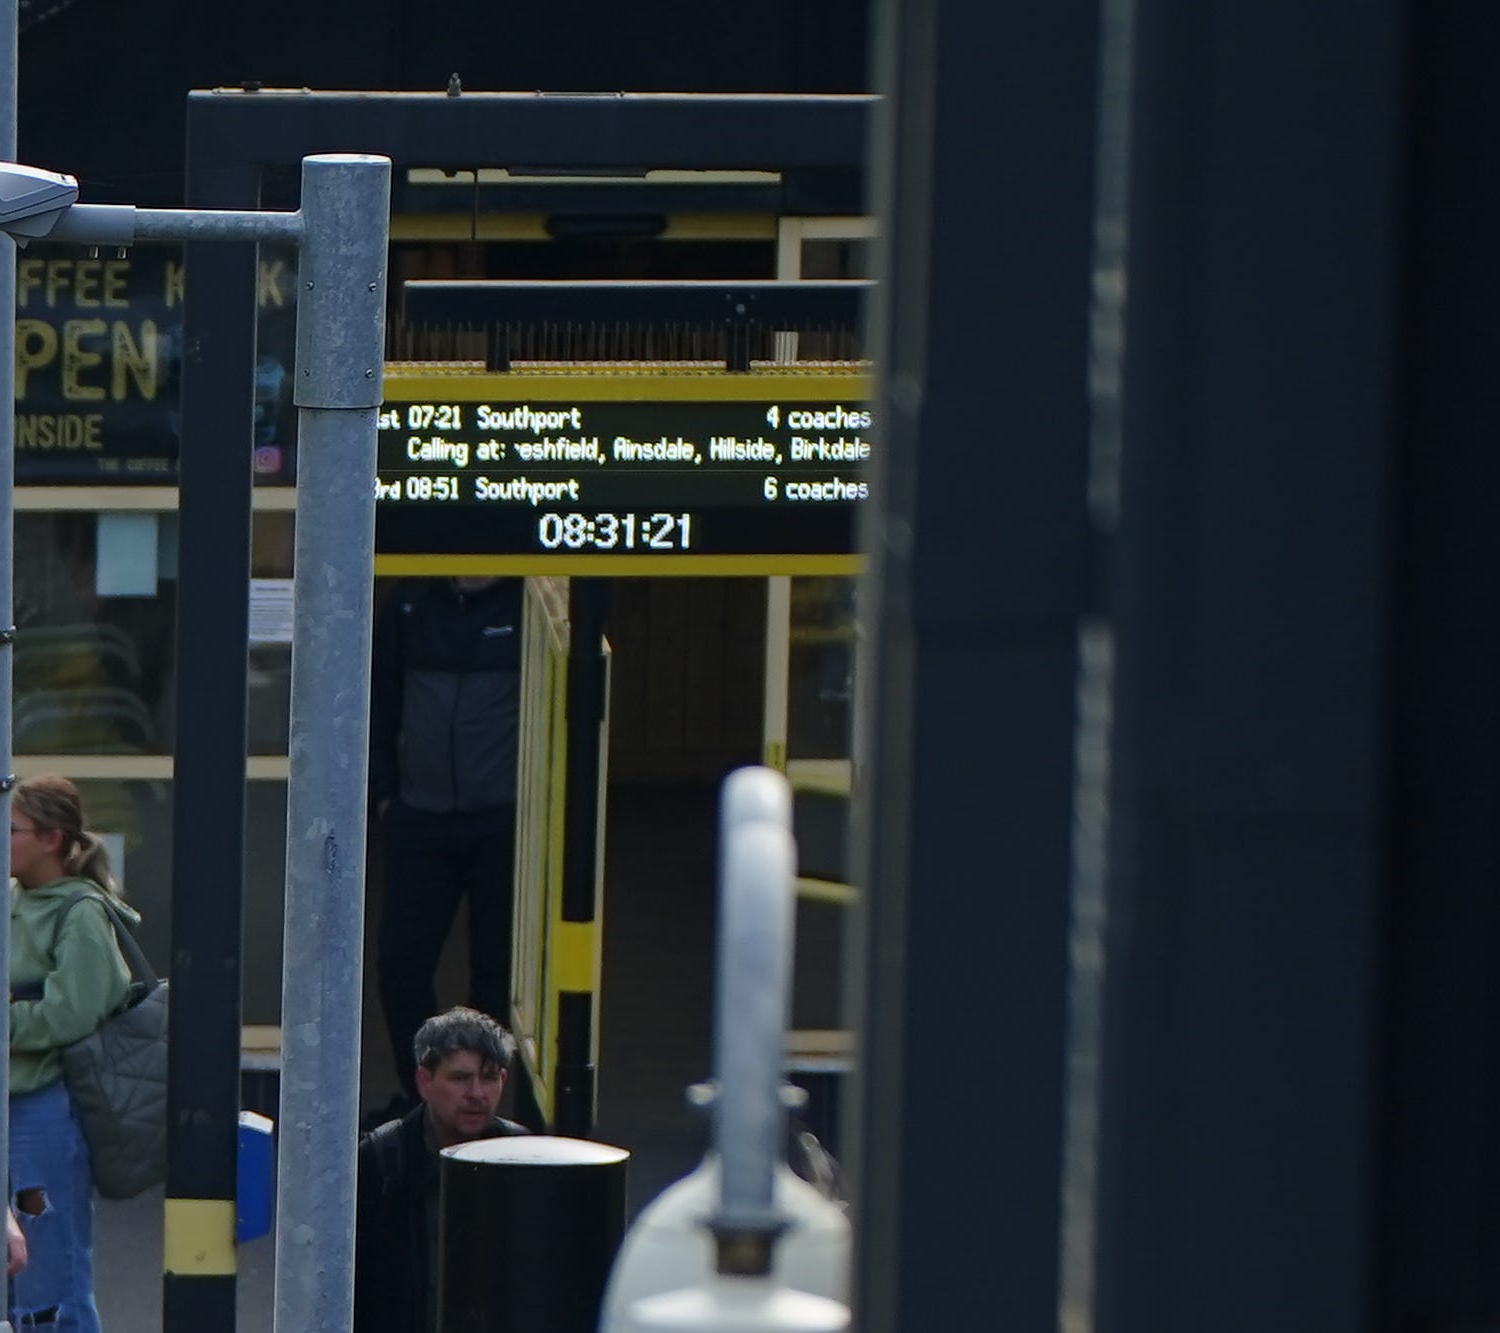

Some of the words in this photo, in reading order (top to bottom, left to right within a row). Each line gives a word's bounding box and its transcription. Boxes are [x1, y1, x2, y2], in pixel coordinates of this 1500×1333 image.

[17, 258, 132, 308] FFEE
[14, 317, 159, 402] PEN
[14, 413, 105, 450] NSIDE
[408, 404, 462, 430] 07:21
[476, 404, 582, 435] Southport
[766, 405, 780, 430] 4
[787, 404, 873, 430] coaches
[407, 436, 470, 467] Calling
[476, 438, 506, 461] at:
[513, 436, 607, 466] eshfield,
[613, 436, 702, 465] Ainsdale,
[709, 436, 783, 465] Hillside,
[790, 436, 872, 461] Birkdale
[405, 476, 459, 501] 08:51
[474, 476, 580, 507] Southport
[763, 476, 778, 501] 6
[785, 476, 870, 501] coaches
[539, 513, 691, 549] 08:31:21
